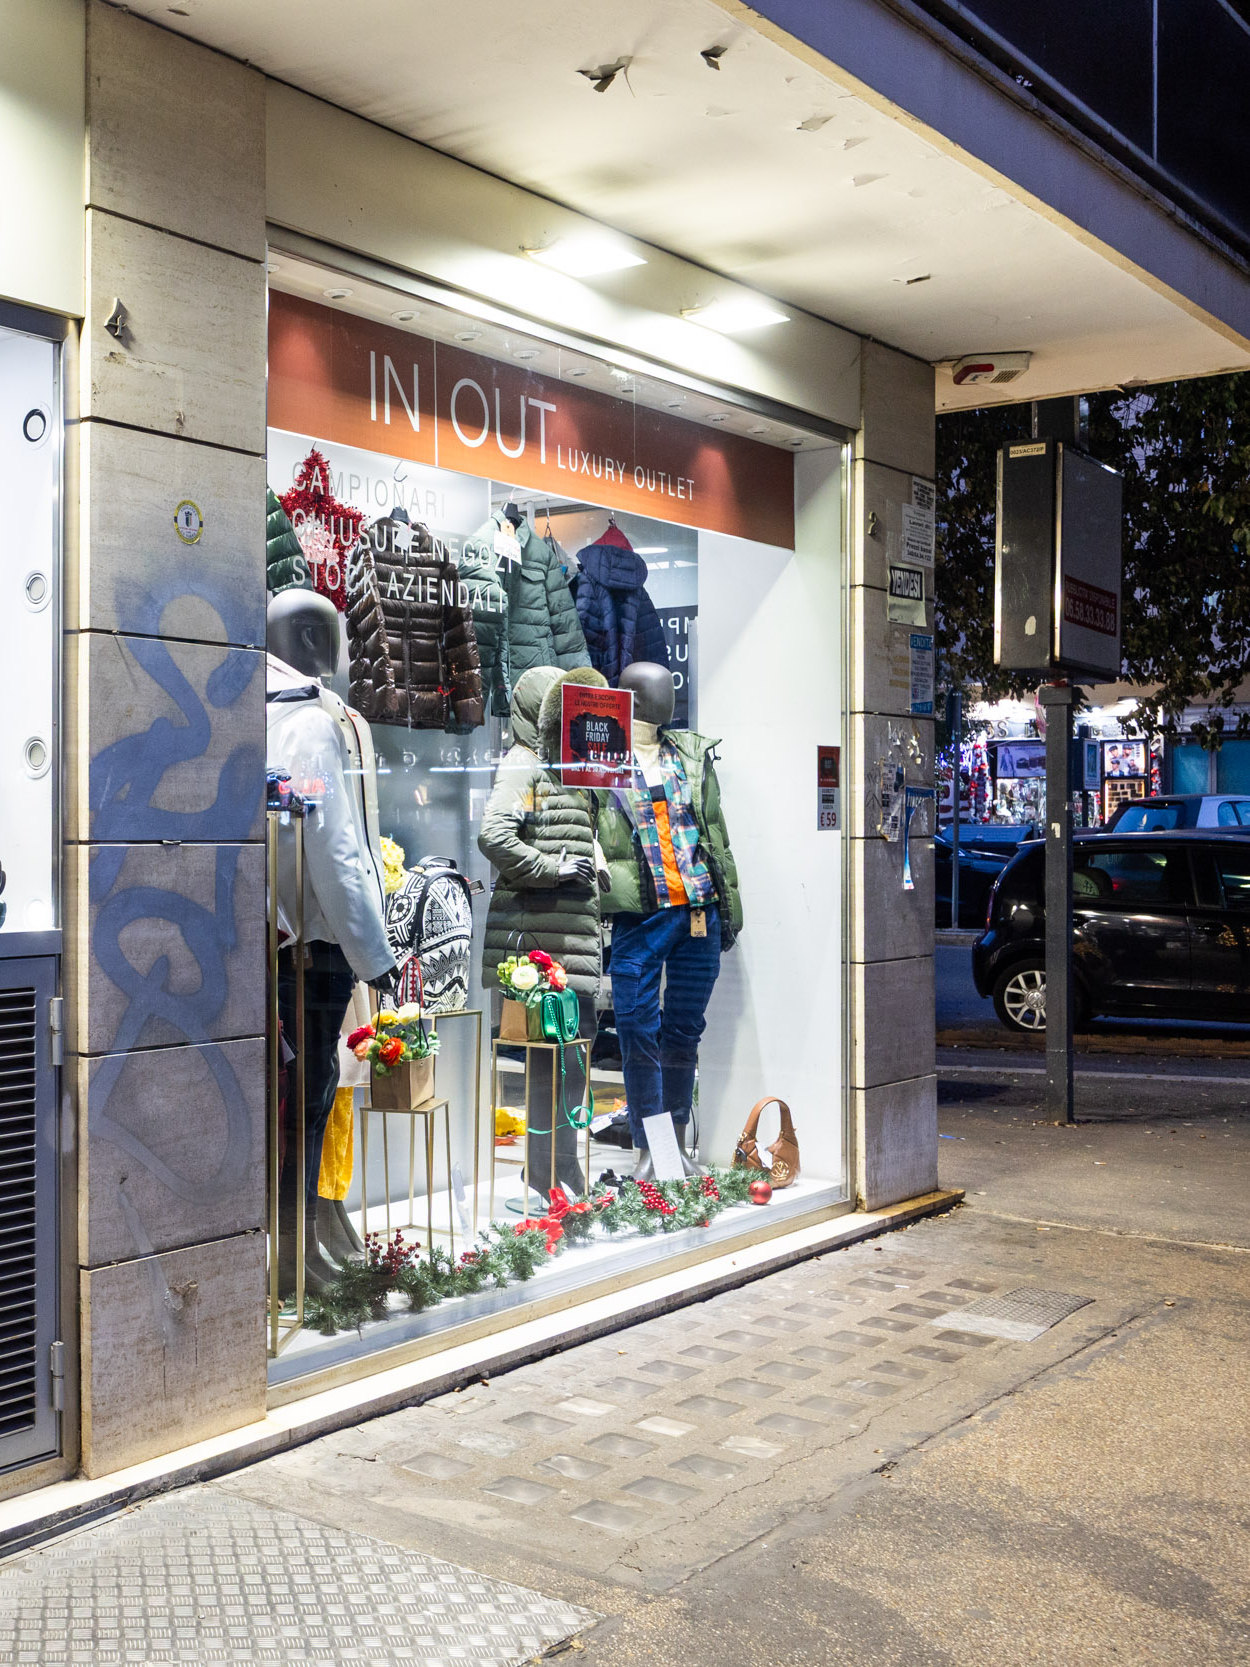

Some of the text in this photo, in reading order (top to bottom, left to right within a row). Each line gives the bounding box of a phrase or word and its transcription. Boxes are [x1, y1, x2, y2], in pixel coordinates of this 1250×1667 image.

[370, 350, 557, 465] IN OUT
[292, 461, 446, 519] CAMPIONARI
[557, 444, 695, 502] LUXURY OUTLET
[432, 533, 513, 575] NEGOZI
[292, 555, 504, 614] STOCK AZIENDALI
[891, 568, 921, 599] VENDESI
[585, 731, 610, 743] FRIDAY
[586, 721, 609, 732] BLACK
[587, 741, 607, 755] SALE
[826, 811, 837, 827] 59
